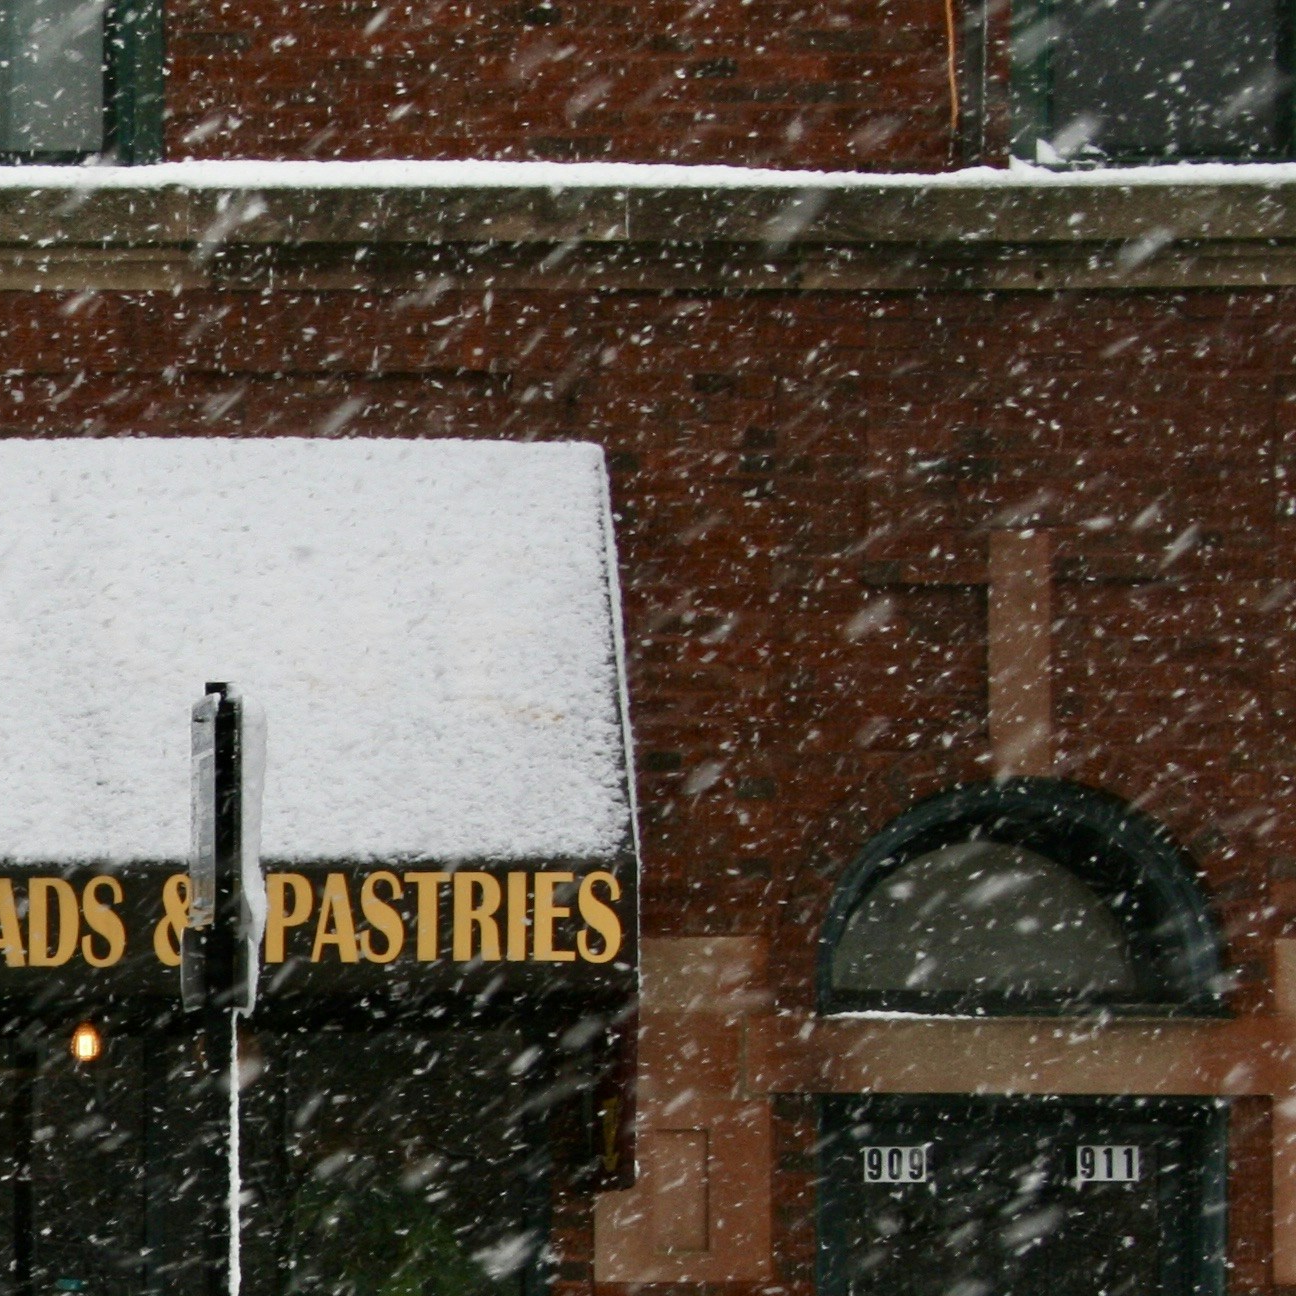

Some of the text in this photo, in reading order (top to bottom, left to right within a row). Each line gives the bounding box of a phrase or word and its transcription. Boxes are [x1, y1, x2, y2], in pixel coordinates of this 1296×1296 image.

[153, 872, 204, 967] &
[264, 870, 622, 965] PASTRIES
[867, 1147, 925, 1181] 909
[1079, 1147, 1137, 1181] 911
